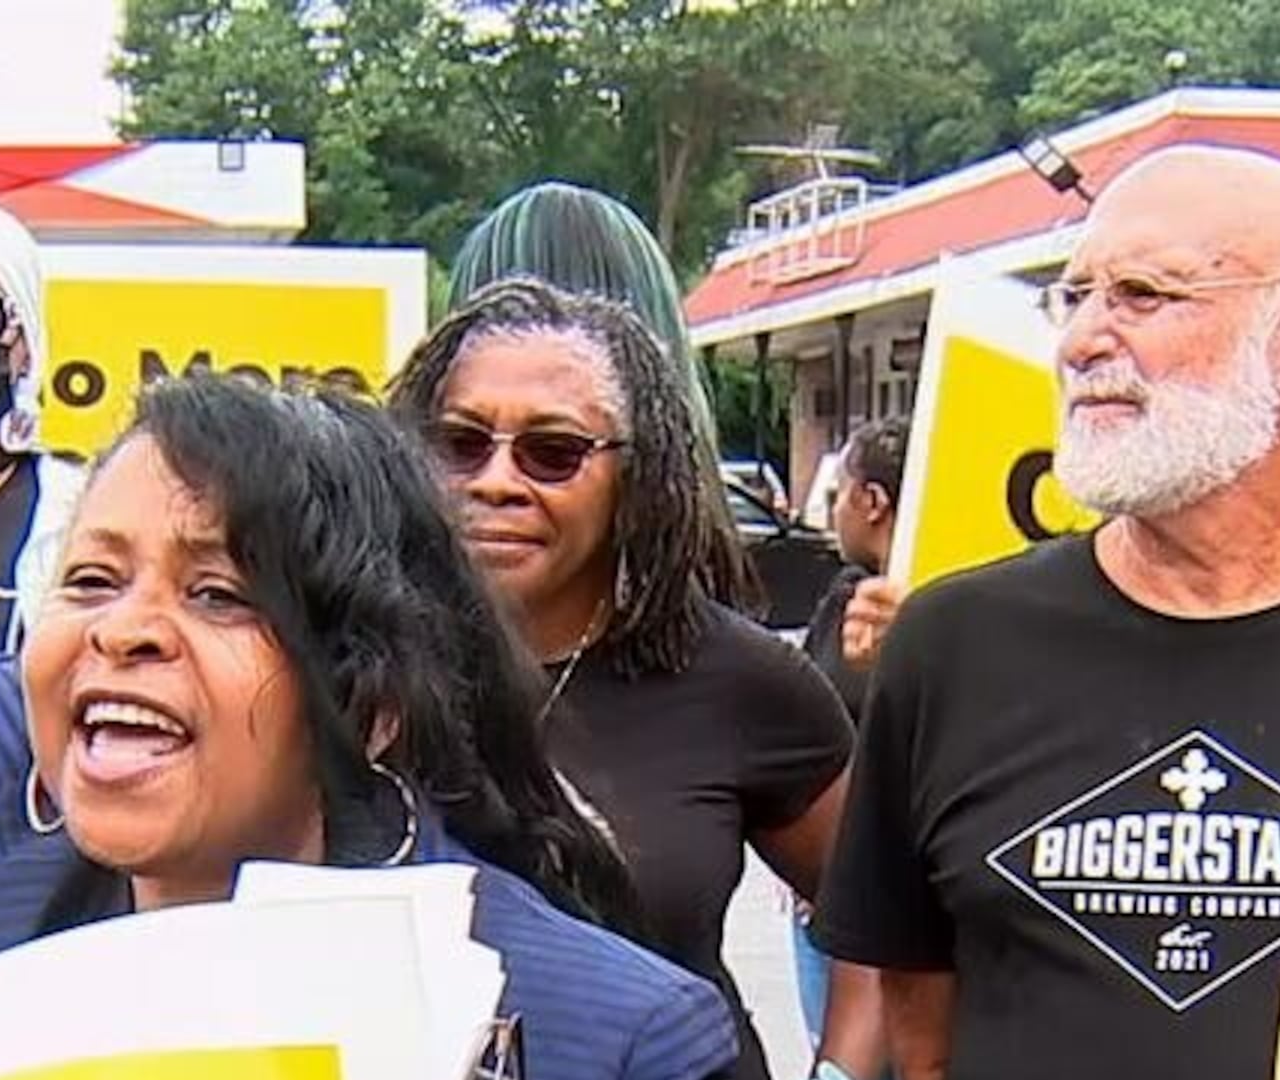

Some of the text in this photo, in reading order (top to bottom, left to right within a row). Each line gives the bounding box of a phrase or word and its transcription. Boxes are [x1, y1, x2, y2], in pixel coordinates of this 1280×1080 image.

[38, 360, 106, 407] o
[1073, 892, 1179, 916] BREWING
[1154, 949, 1211, 972] 2021
